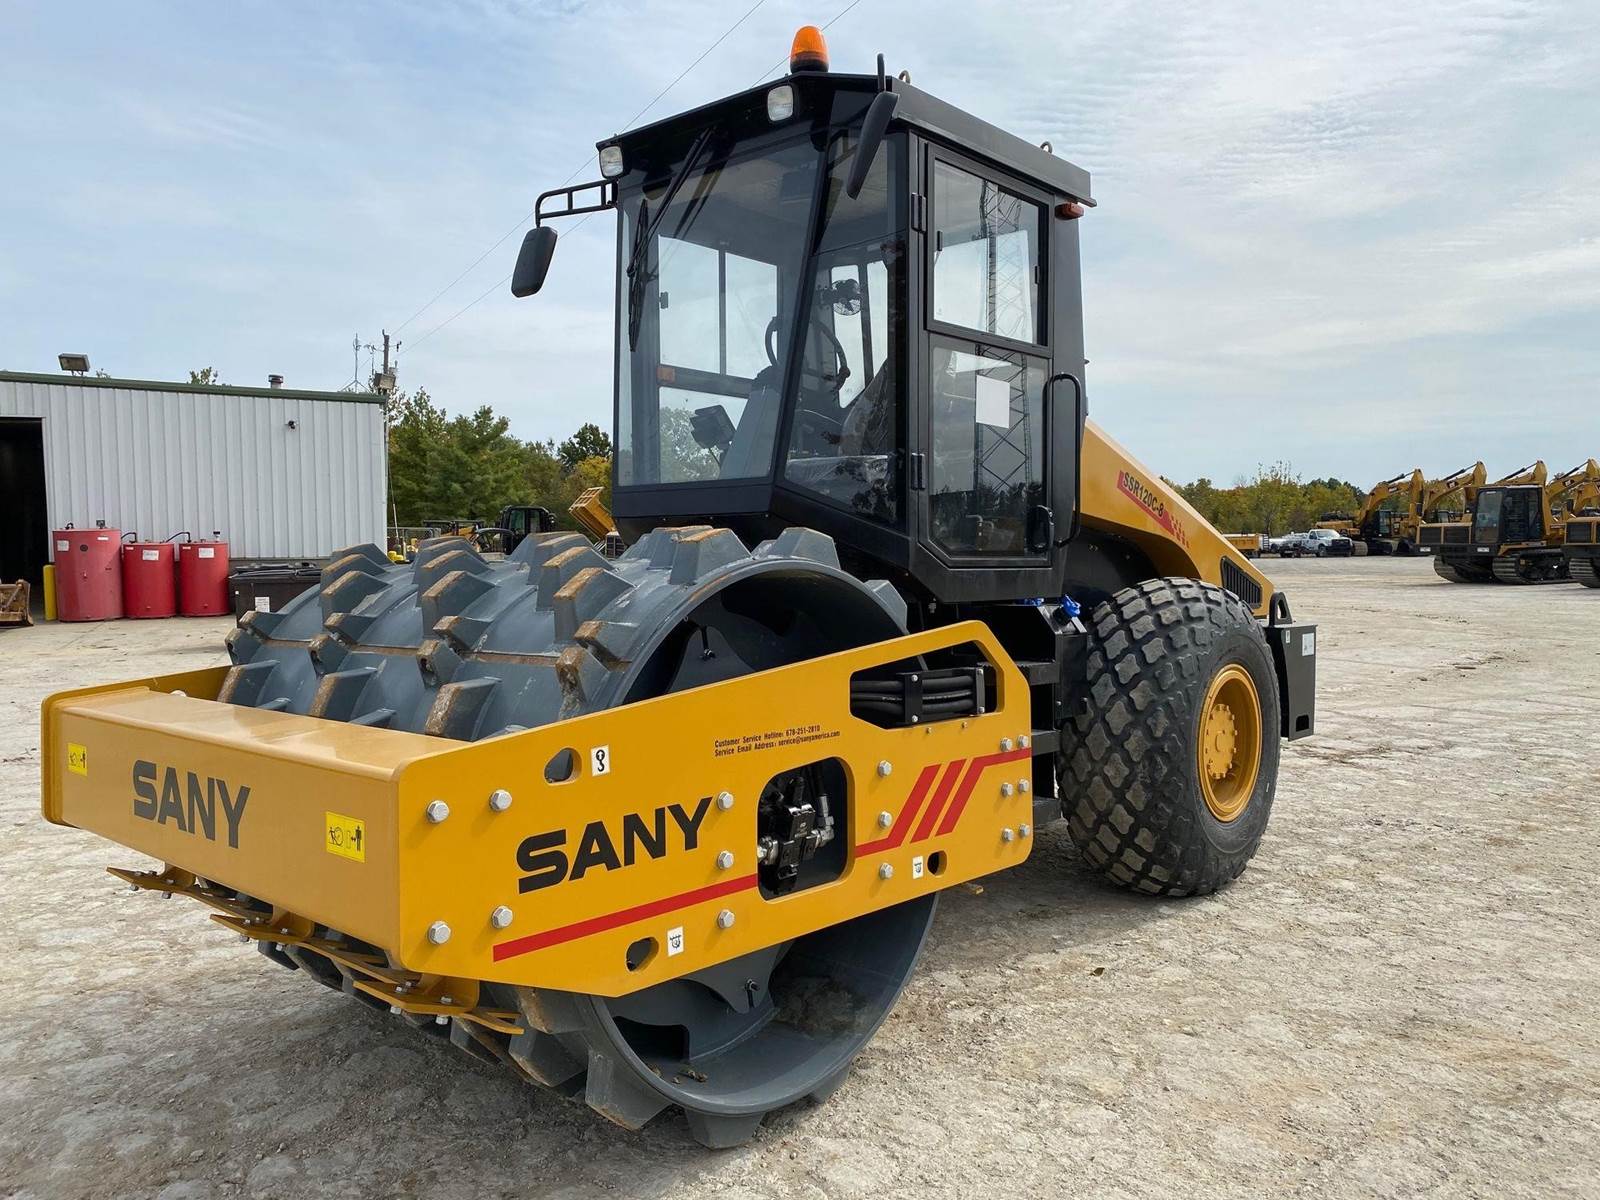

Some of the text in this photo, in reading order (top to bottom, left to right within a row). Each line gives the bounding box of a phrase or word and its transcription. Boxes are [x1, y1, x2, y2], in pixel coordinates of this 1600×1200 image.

[1123, 472, 1164, 517] SSR120C-8
[714, 738, 741, 748] Customer
[742, 734, 762, 744] Service
[763, 731, 784, 740] Hotline:
[714, 748, 735, 757] Service
[737, 744, 752, 753] Email
[754, 741, 777, 750] Address:
[133, 759, 251, 849] SANY
[516, 796, 713, 895] SANY
